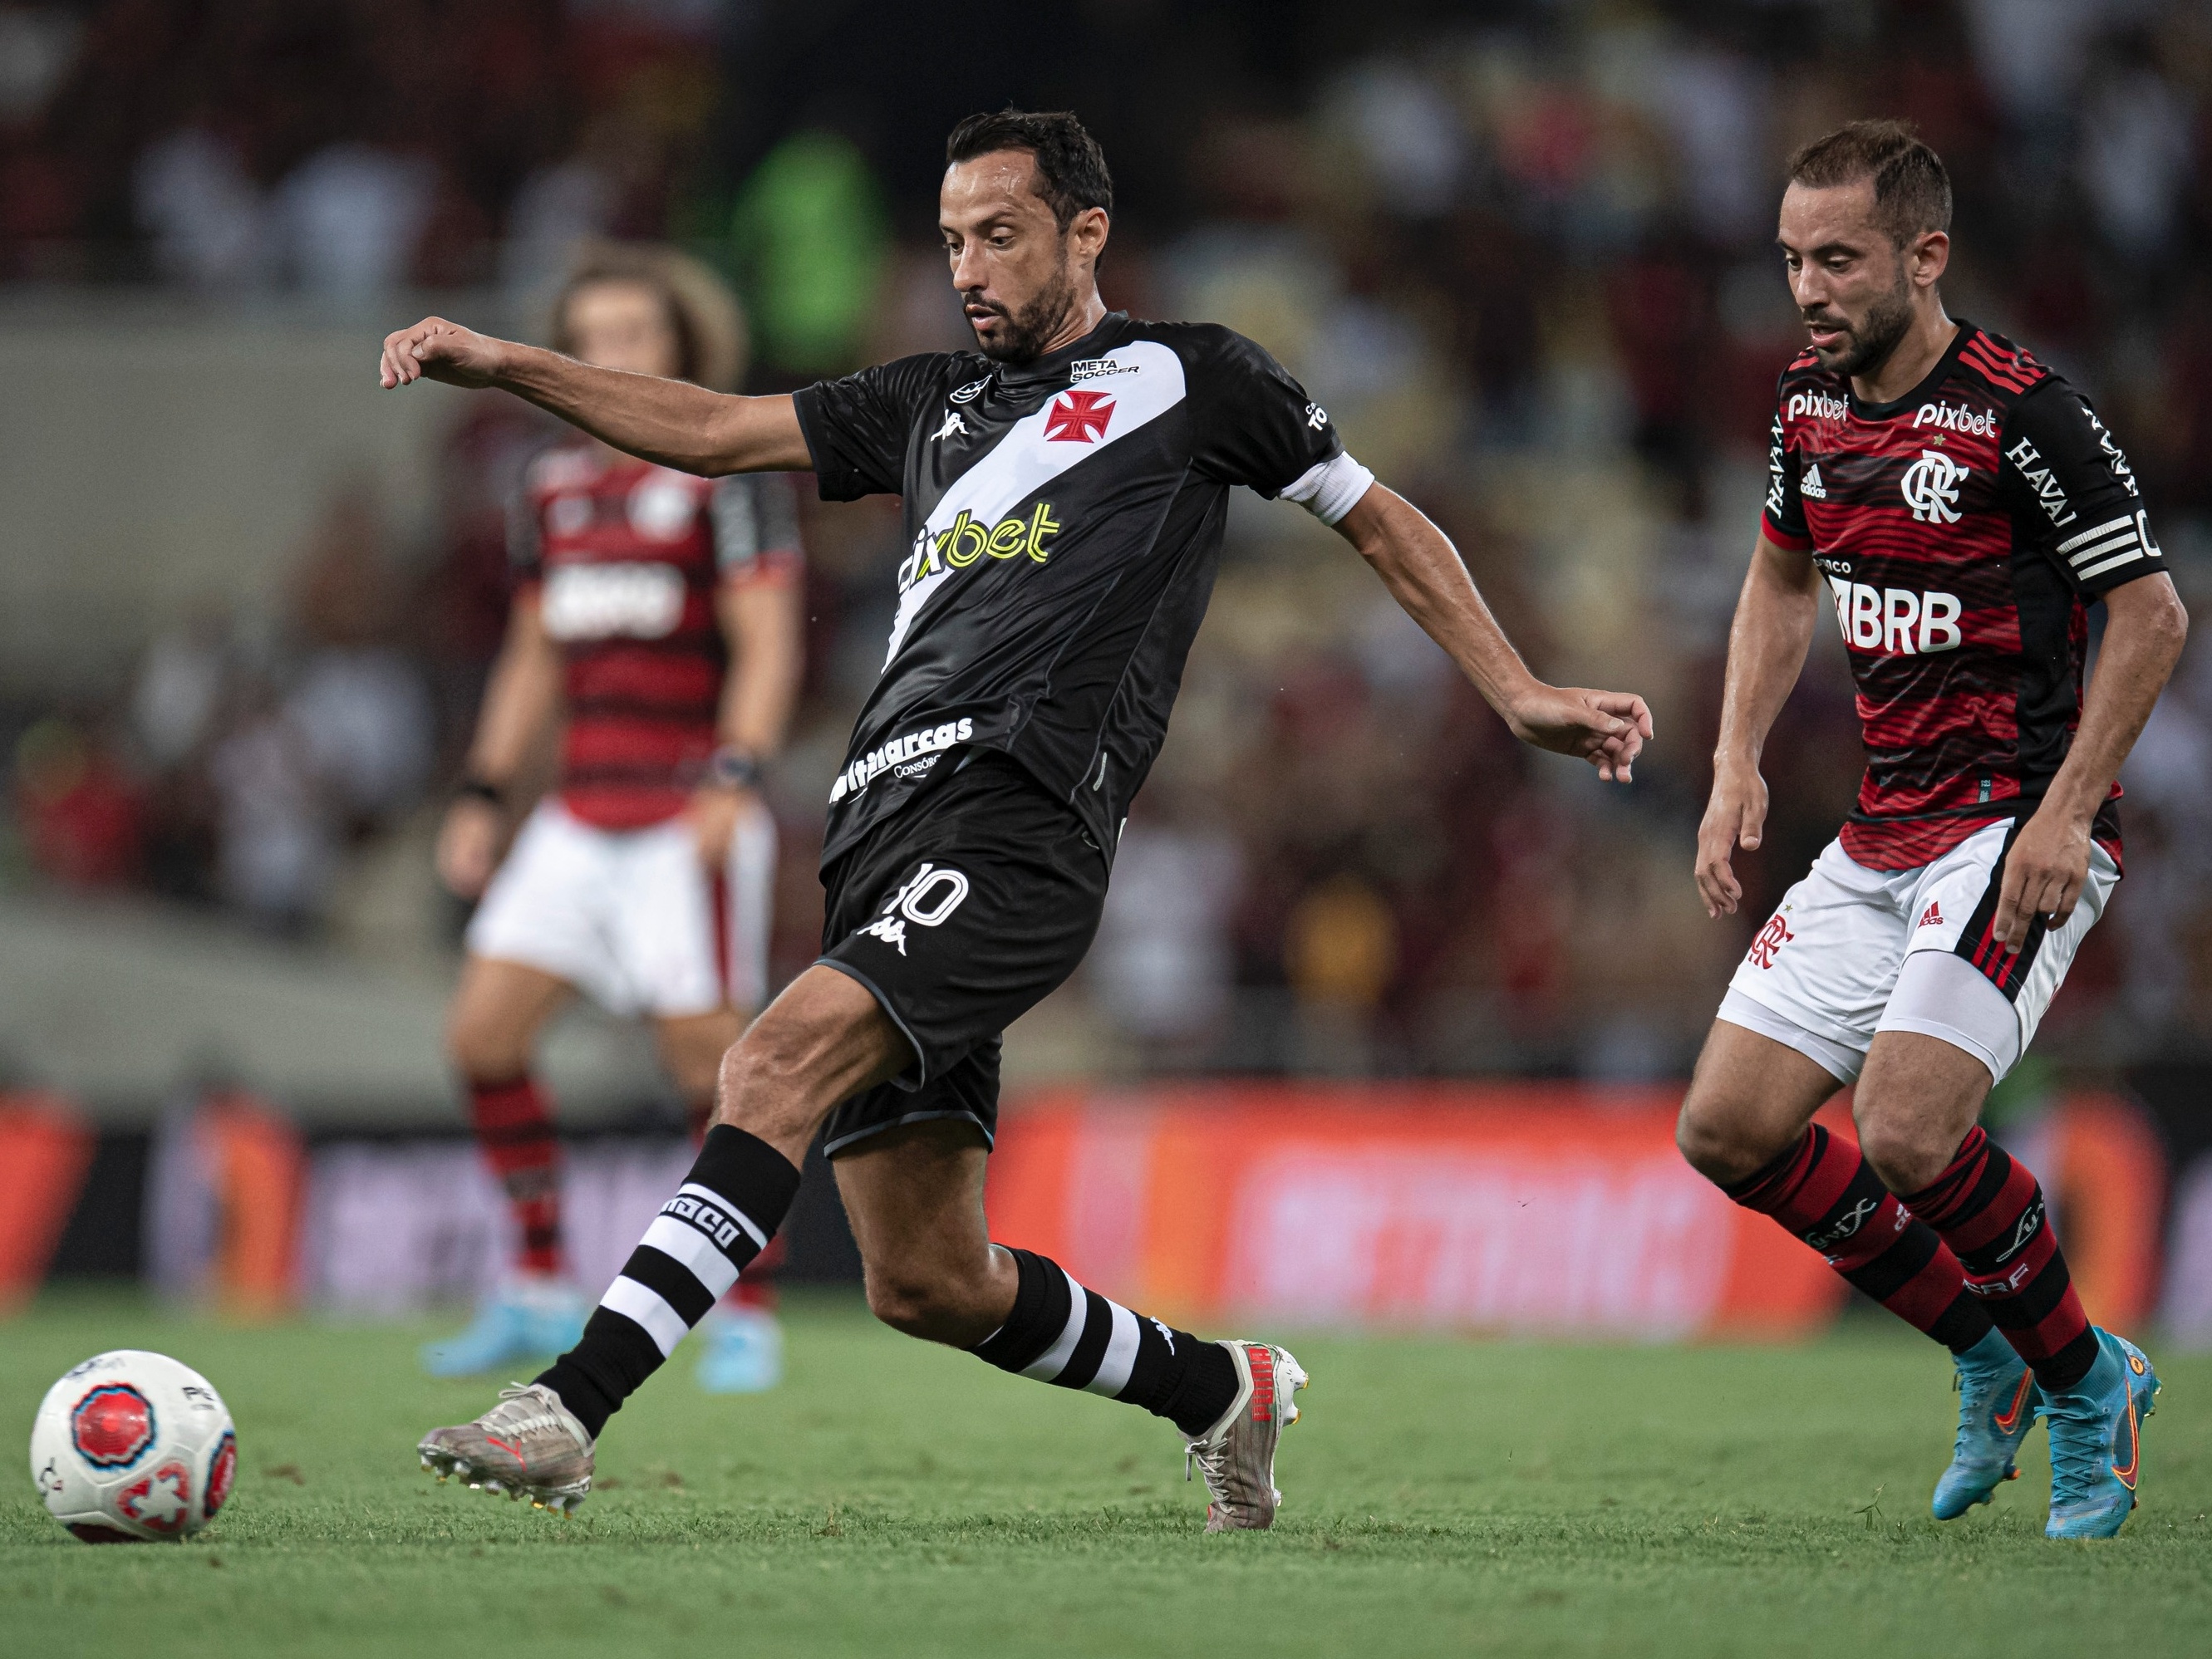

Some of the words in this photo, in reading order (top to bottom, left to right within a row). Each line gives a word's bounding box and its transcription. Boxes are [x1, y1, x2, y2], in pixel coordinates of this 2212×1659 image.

[1071, 366, 1140, 382] SOCCER
[1073, 360, 1118, 373] META
[1787, 388, 1850, 422] pixbet
[1912, 400, 1996, 438] pixbet
[1800, 483, 1827, 499] adidas
[1852, 582, 1962, 655] BRB
[882, 863, 969, 927] 10
[1249, 1347, 1274, 1422] PUMA
